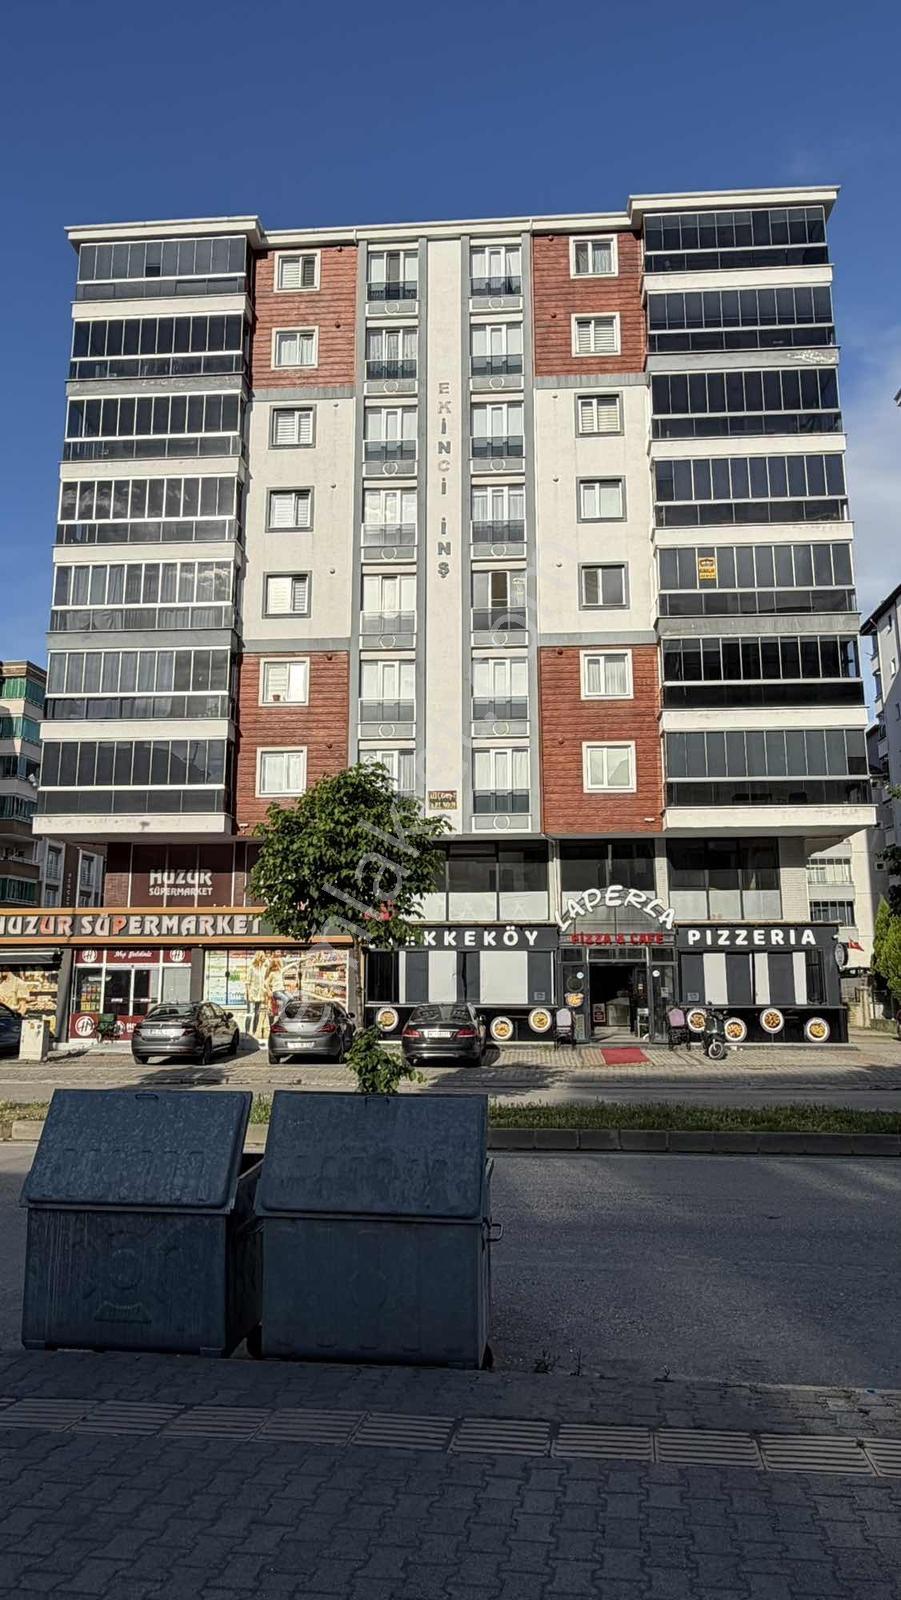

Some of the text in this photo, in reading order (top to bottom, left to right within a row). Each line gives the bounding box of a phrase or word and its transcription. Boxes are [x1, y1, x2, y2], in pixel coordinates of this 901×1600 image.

[149, 886, 213, 896] SÜPERMARKET
[555, 884, 675, 932] LAPERLA
[81, 914, 262, 936] SÜPERMARKET
[687, 929, 817, 945] PIZZERIA
